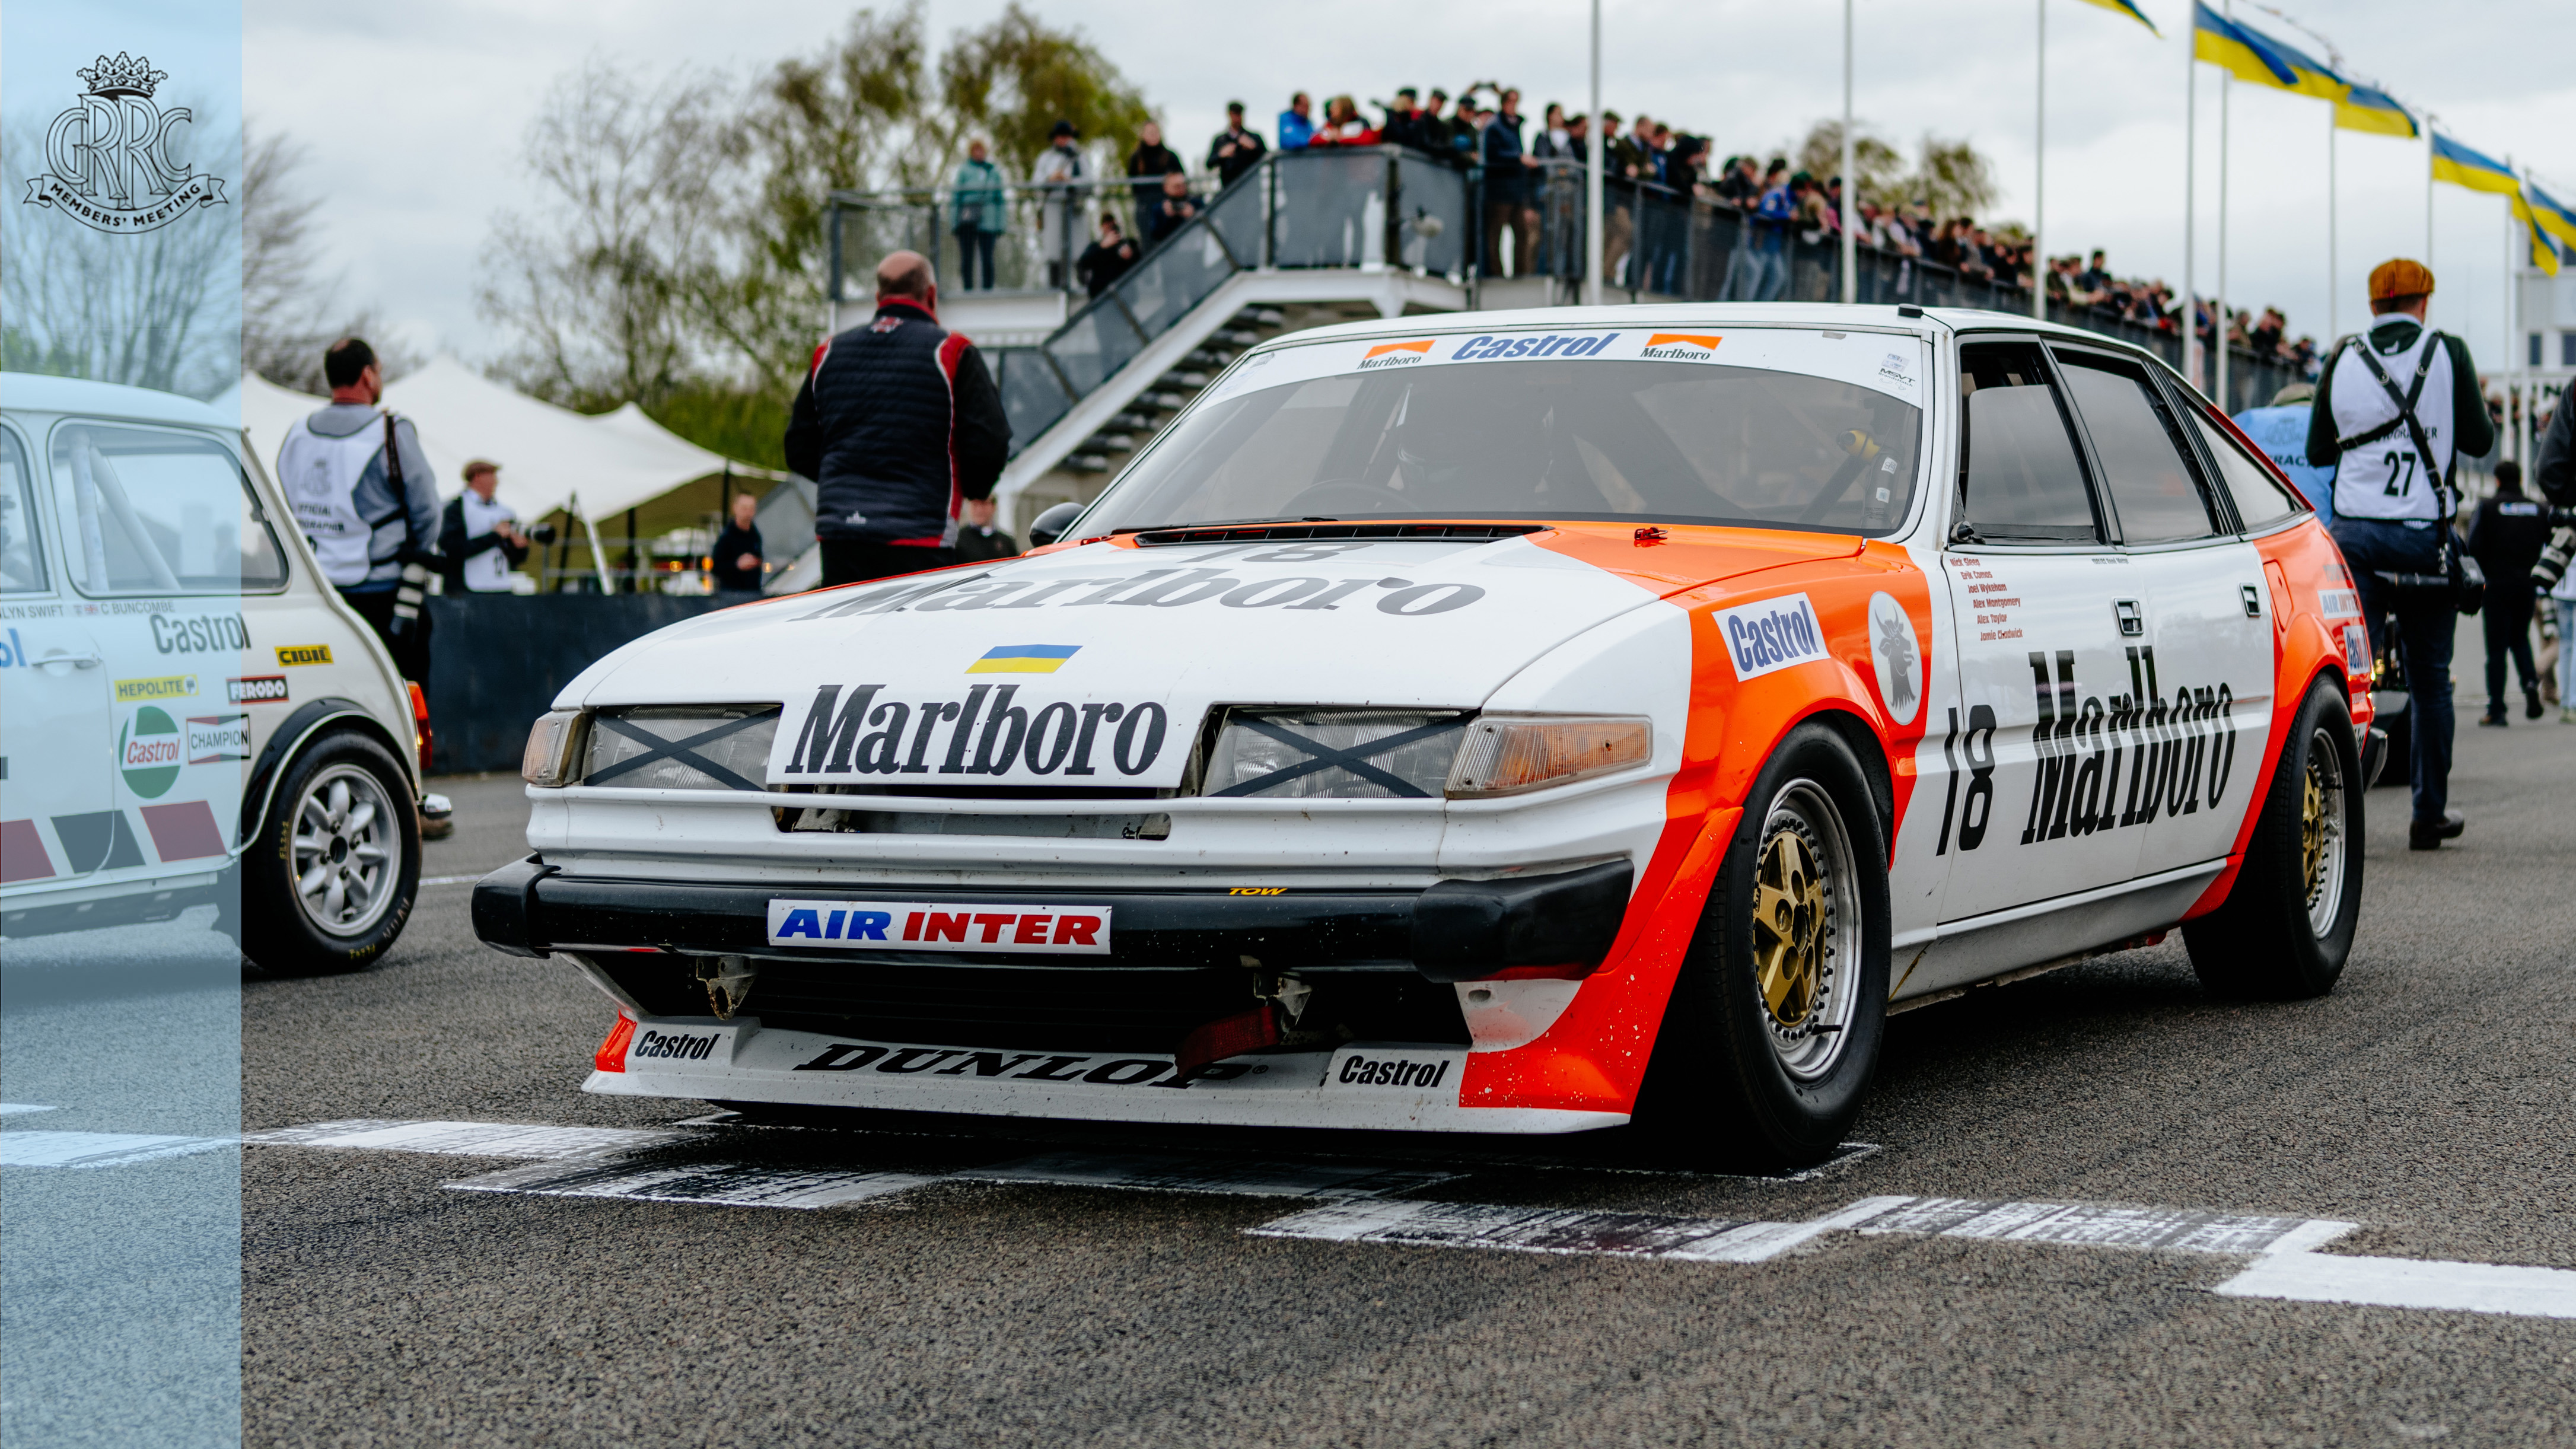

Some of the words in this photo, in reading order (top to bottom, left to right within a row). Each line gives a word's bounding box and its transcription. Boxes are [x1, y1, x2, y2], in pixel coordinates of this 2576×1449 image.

[1451, 333, 1621, 361] Castrol
[1639, 348, 1711, 360] Marlboro
[1357, 356, 1422, 370] Marlboro
[1880, 368, 1916, 383] MSVT
[2383, 450, 2416, 497] 27
[1176, 543, 1375, 563] 18
[1950, 558, 1964, 567] Nick
[1960, 571, 1973, 579] Erik
[1973, 571, 1993, 579] Comas
[785, 568, 1486, 622] Marlboro
[1968, 584, 1979, 594] Joel
[1979, 582, 2007, 594] Wykeham
[0, 605, 26, 619] LYN
[28, 603, 63, 619] SWIFT
[101, 603, 109, 614] C
[113, 601, 176, 614] BUNCOMBE
[1973, 598, 1986, 609] Alex
[1986, 598, 2021, 608] Montgomery
[2322, 594, 2340, 614] AIR
[1977, 614, 1989, 624] Alex
[1990, 613, 2007, 625] Taylor
[149, 612, 251, 654] Castrol
[1728, 600, 1817, 672] Castrol
[1980, 630, 1997, 641] Jamie
[1998, 628, 2023, 640] Chadwick
[118, 679, 183, 698] HEPOLITE
[230, 679, 285, 699] FERODO
[190, 730, 248, 750] CHAMPION
[784, 684, 1167, 776] Marlboro
[127, 738, 180, 765] Castrol
[2020, 645, 2236, 846] Marlboro
[1935, 704, 1997, 856] 18
[1229, 887, 1288, 896] TOW
[776, 908, 892, 941] AIR
[902, 911, 1103, 946] INTER
[635, 1030, 721, 1060] Castrol
[792, 1043, 1253, 1090] DUNLOP
[1339, 1055, 1451, 1088] Castrol
